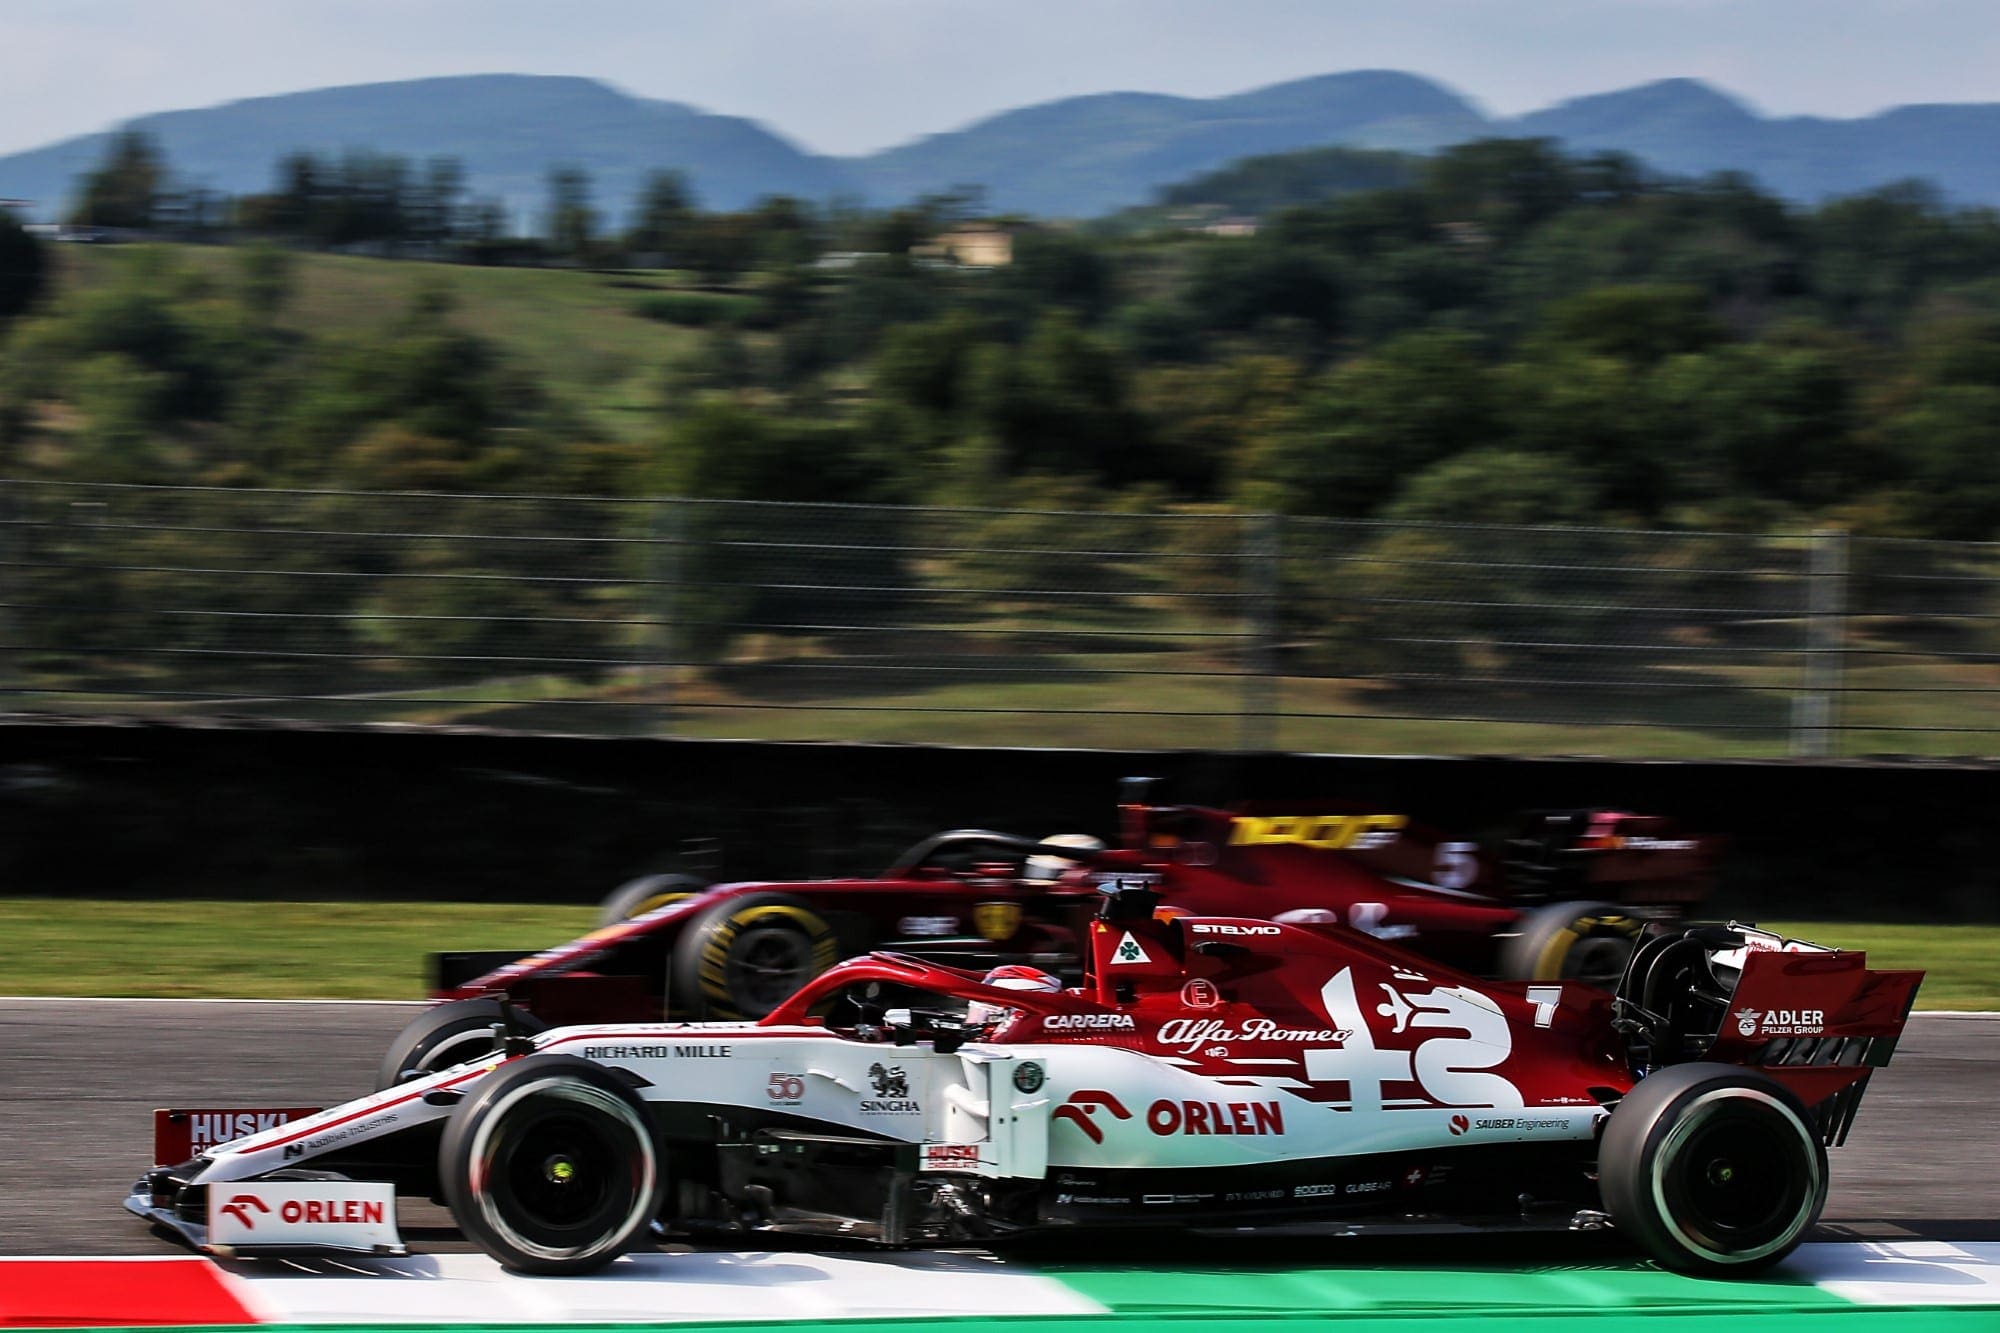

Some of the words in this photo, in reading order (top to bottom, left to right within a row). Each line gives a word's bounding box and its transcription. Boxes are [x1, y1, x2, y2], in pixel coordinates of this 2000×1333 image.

[1431, 841, 1479, 888] 5
[1191, 924, 1281, 935] STELVIO
[1526, 985, 1562, 1028] 7
[1043, 1014, 1135, 1028] CARRERA
[1762, 1010, 1824, 1025] ADLER
[1156, 1018, 1239, 1054] Alfa
[1240, 1018, 1353, 1042] Romeo
[1794, 1025, 1824, 1034] GROUP
[585, 1046, 667, 1058] RICHARD
[675, 1045, 732, 1058] MILLE
[766, 1072, 805, 1099] 50
[860, 1101, 920, 1111] SINGHA
[1147, 1099, 1284, 1136] ORLEN
[1475, 1119, 1515, 1130] SAUBER
[1516, 1118, 1570, 1130] Engineering
[281, 1200, 383, 1223] ORLEN
